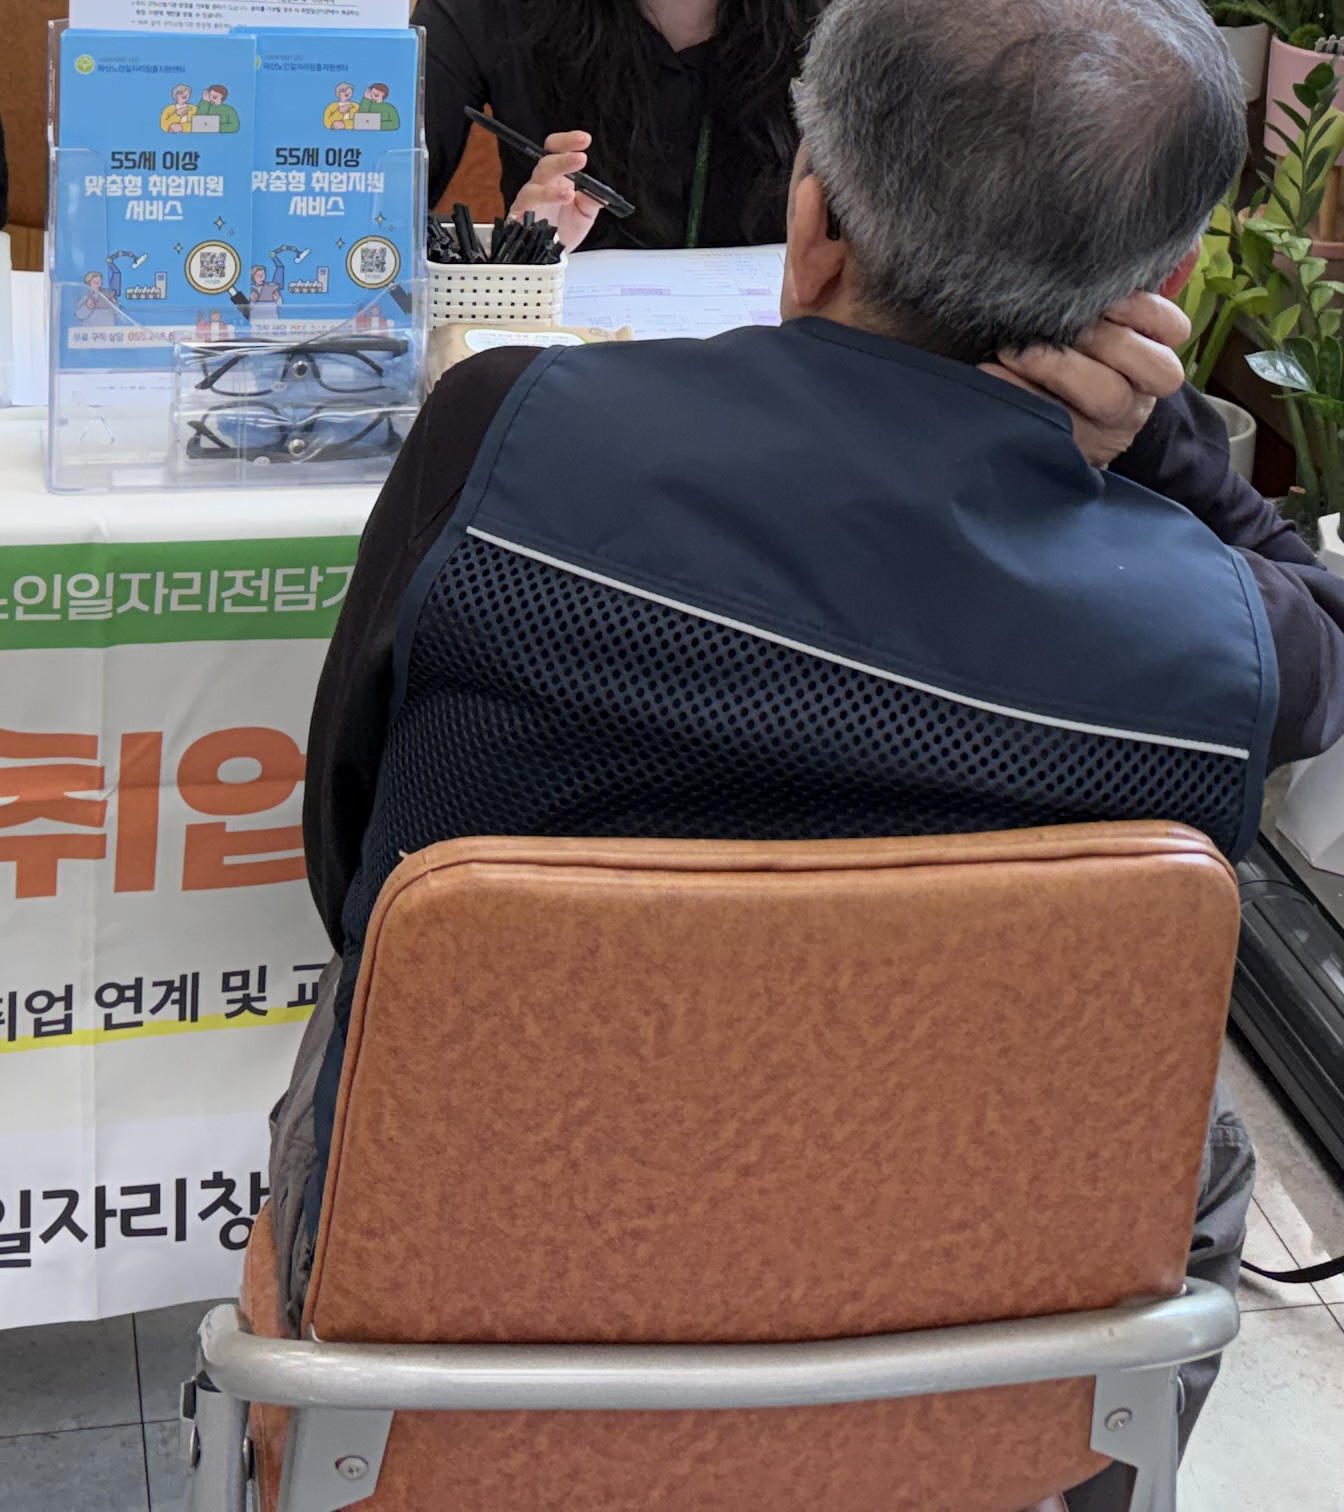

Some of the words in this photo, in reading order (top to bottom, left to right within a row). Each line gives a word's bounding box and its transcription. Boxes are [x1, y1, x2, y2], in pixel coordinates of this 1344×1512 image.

[110, 150, 156, 171] 55세
[162, 150, 201, 172] 이상
[275, 147, 319, 168] 55세
[325, 147, 362, 168] 이상
[84, 175, 143, 197] 맞춤형
[148, 175, 224, 197] 취업지원
[252, 171, 306, 193] 맞춤형
[311, 171, 384, 193] 취업지원
[126, 200, 183, 221] 서비스
[288, 196, 345, 217] 서비스
[94, 970, 201, 1030] 연계
[221, 965, 269, 1018] 및
